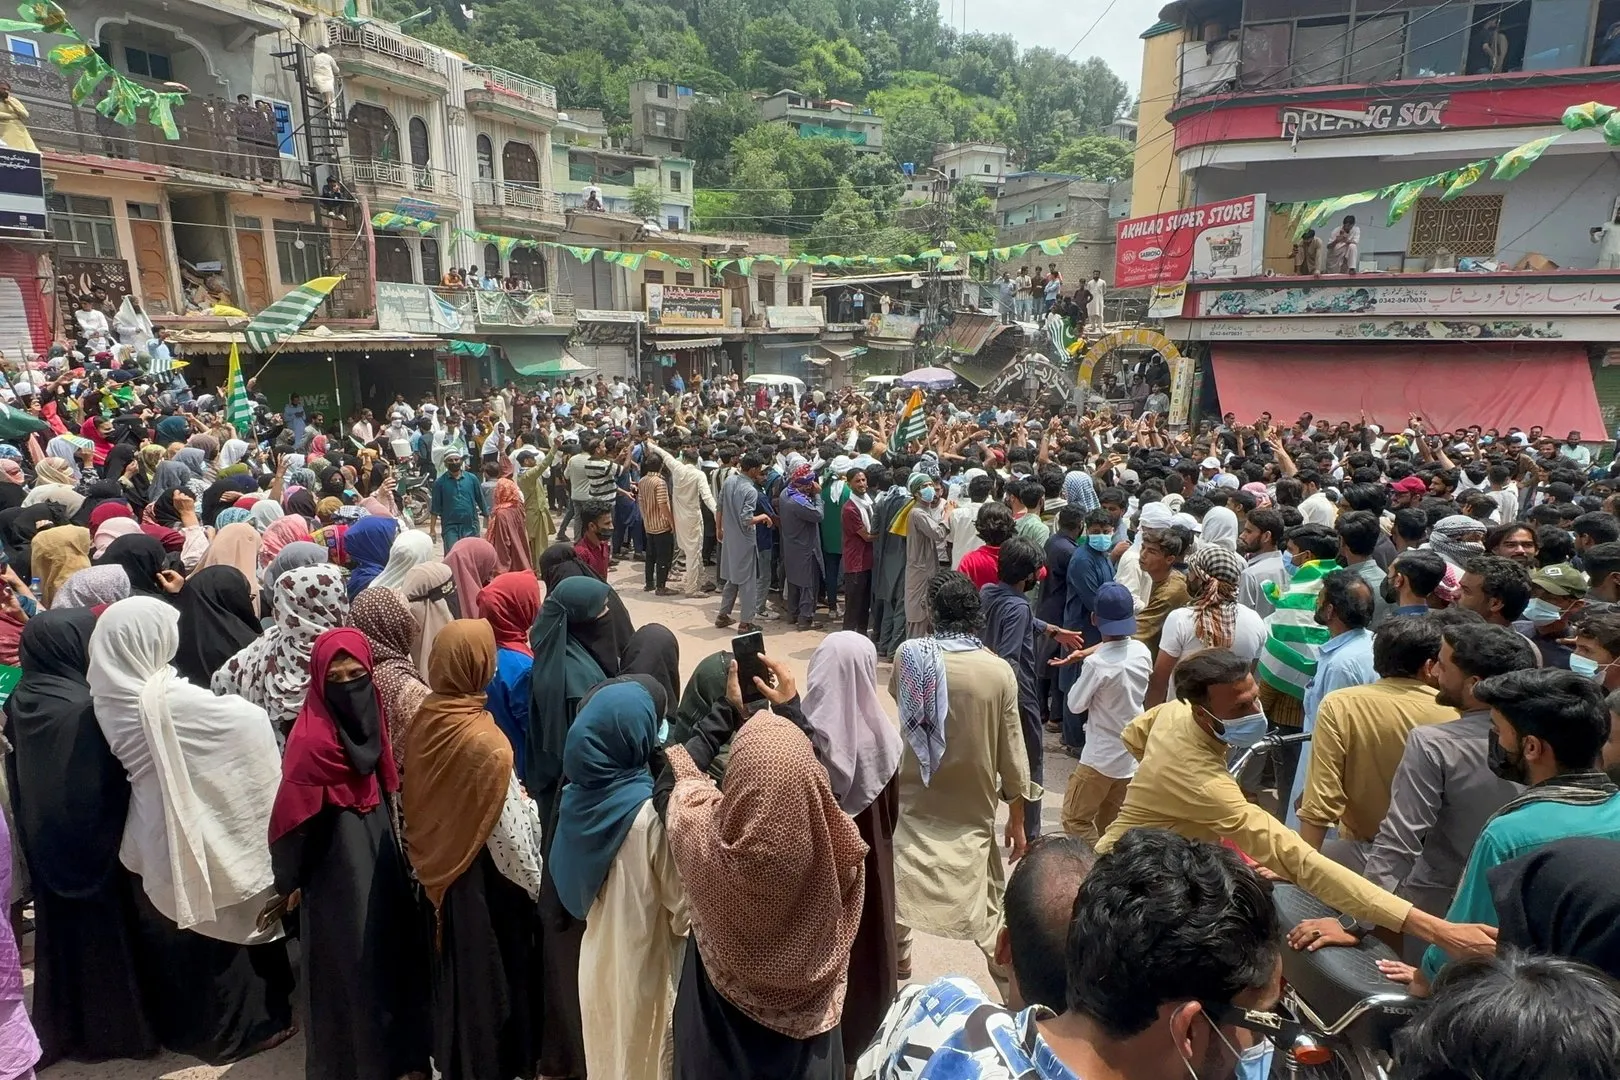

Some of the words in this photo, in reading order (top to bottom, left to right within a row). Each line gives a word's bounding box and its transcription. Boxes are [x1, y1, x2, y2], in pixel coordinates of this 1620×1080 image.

[1120, 217, 1164, 240] AKHLAQ
[1166, 209, 1205, 234] SUPER
[1208, 201, 1253, 225] STORE
[1428, 286, 1463, 312] شاپ
[1382, 1005, 1418, 1016] HON
